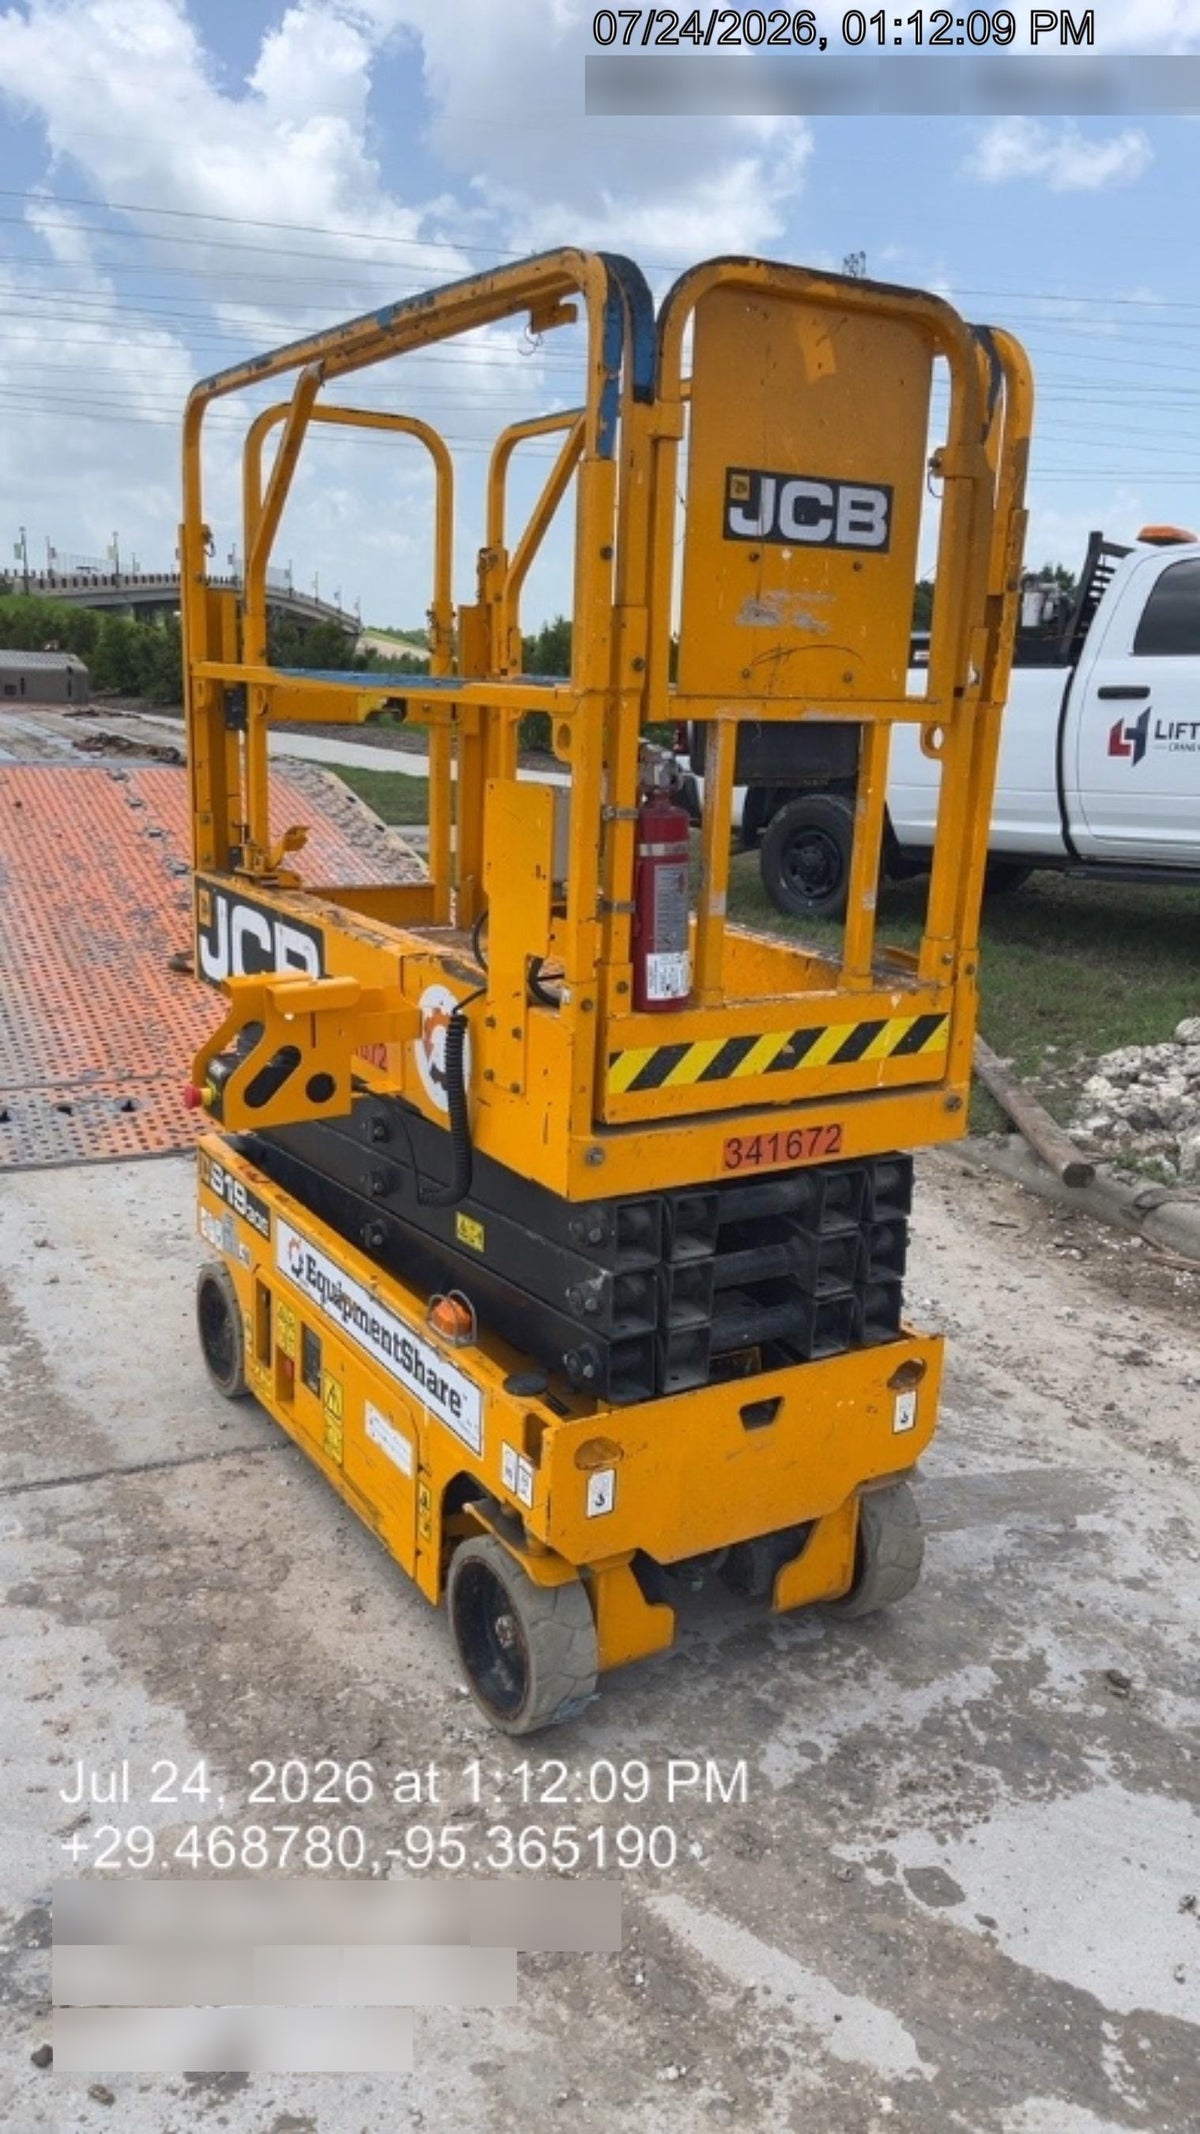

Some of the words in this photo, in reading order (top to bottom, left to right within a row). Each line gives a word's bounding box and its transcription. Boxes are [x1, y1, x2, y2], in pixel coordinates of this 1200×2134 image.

[728, 476, 889, 547] JCB
[724, 1123, 843, 1171] 341672
[304, 1253, 462, 1419] EquipmentShare
